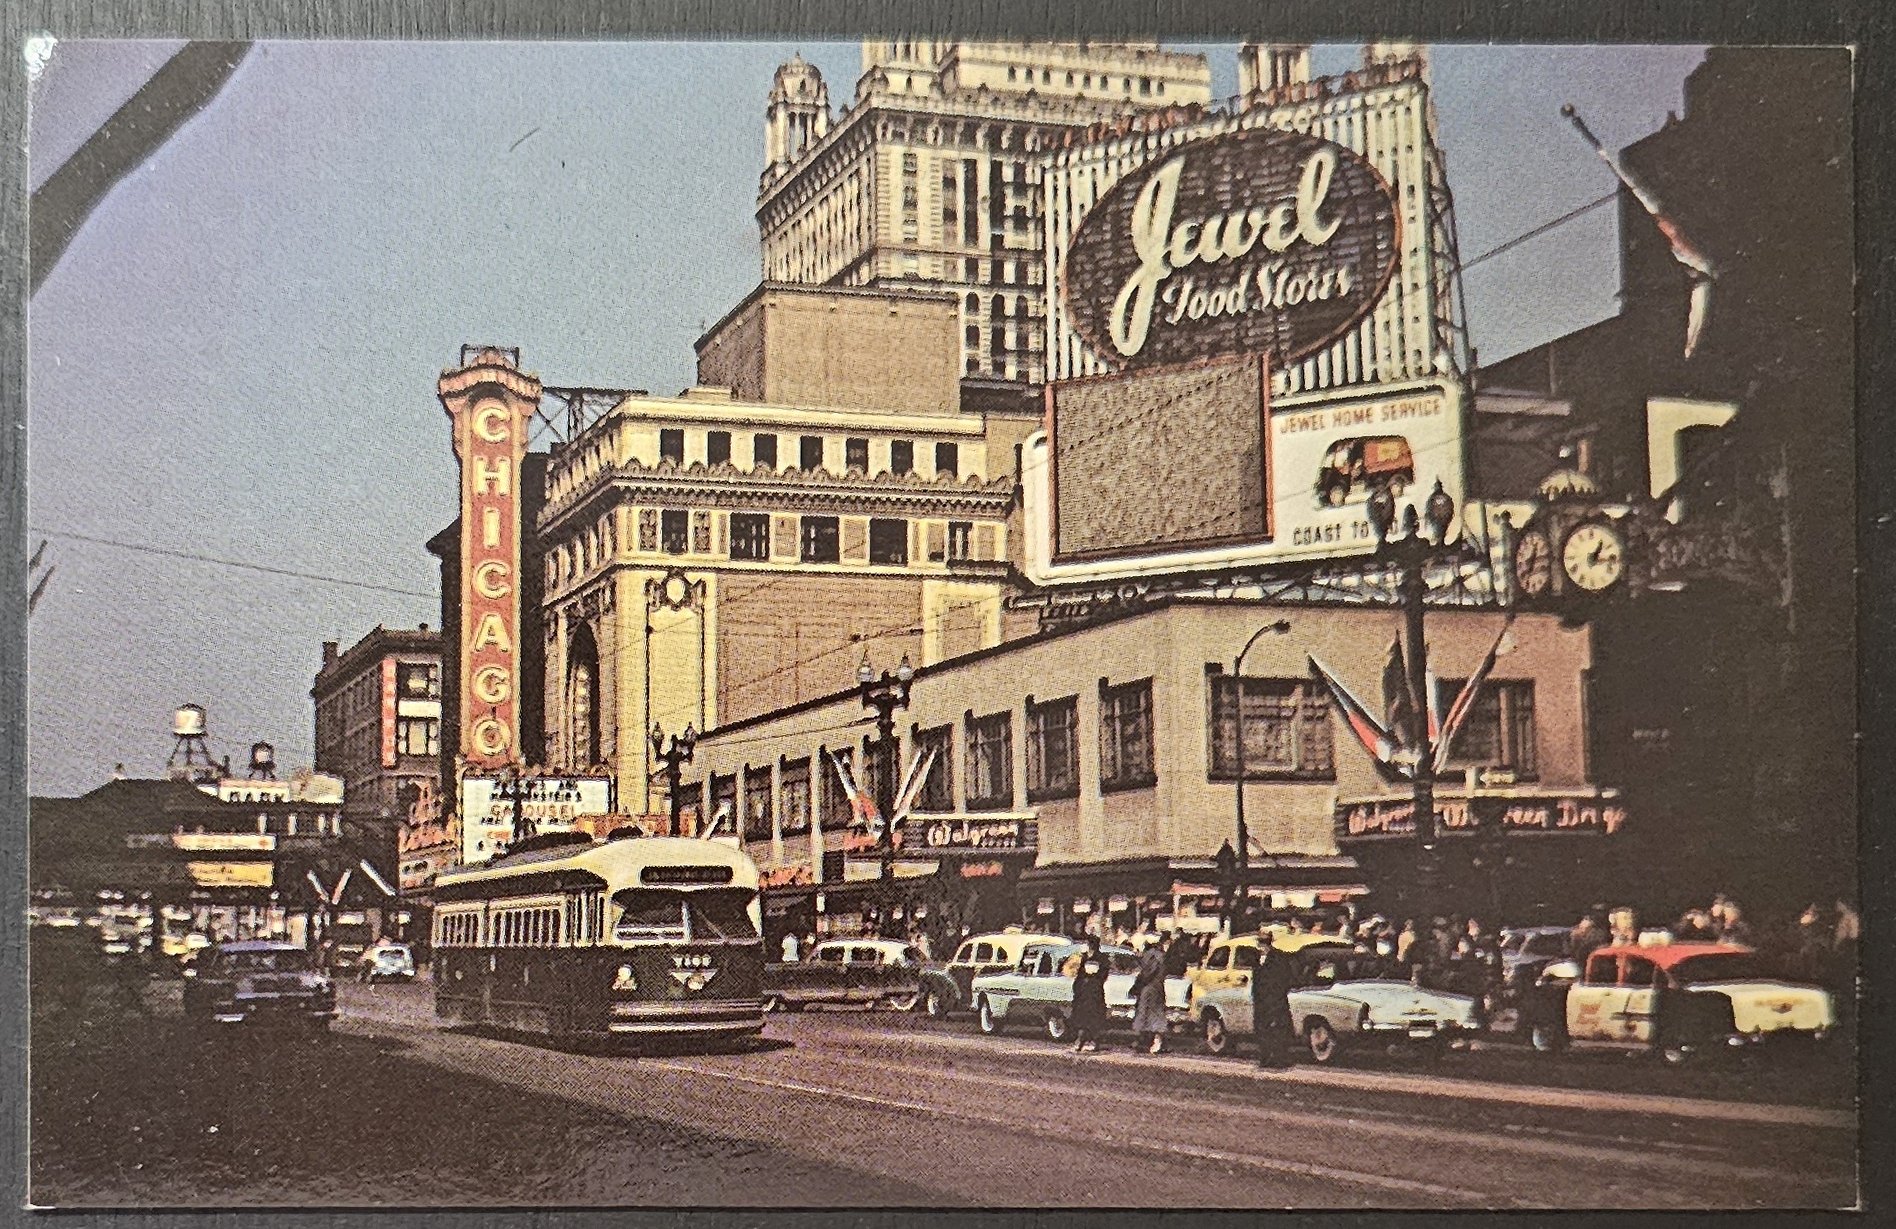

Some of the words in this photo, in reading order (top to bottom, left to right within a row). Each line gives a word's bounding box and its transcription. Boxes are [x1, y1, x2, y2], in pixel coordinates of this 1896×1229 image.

[1109, 146, 1342, 357] Jewel
[1161, 266, 1252, 326] Food
[1280, 413, 1326, 434] JEWEL
[1332, 406, 1374, 428] HOME
[1381, 397, 1441, 423] SERVICE
[1292, 522, 1342, 546] COAST
[1352, 520, 1370, 540] TO
[471, 405, 513, 757] CHICAGO
